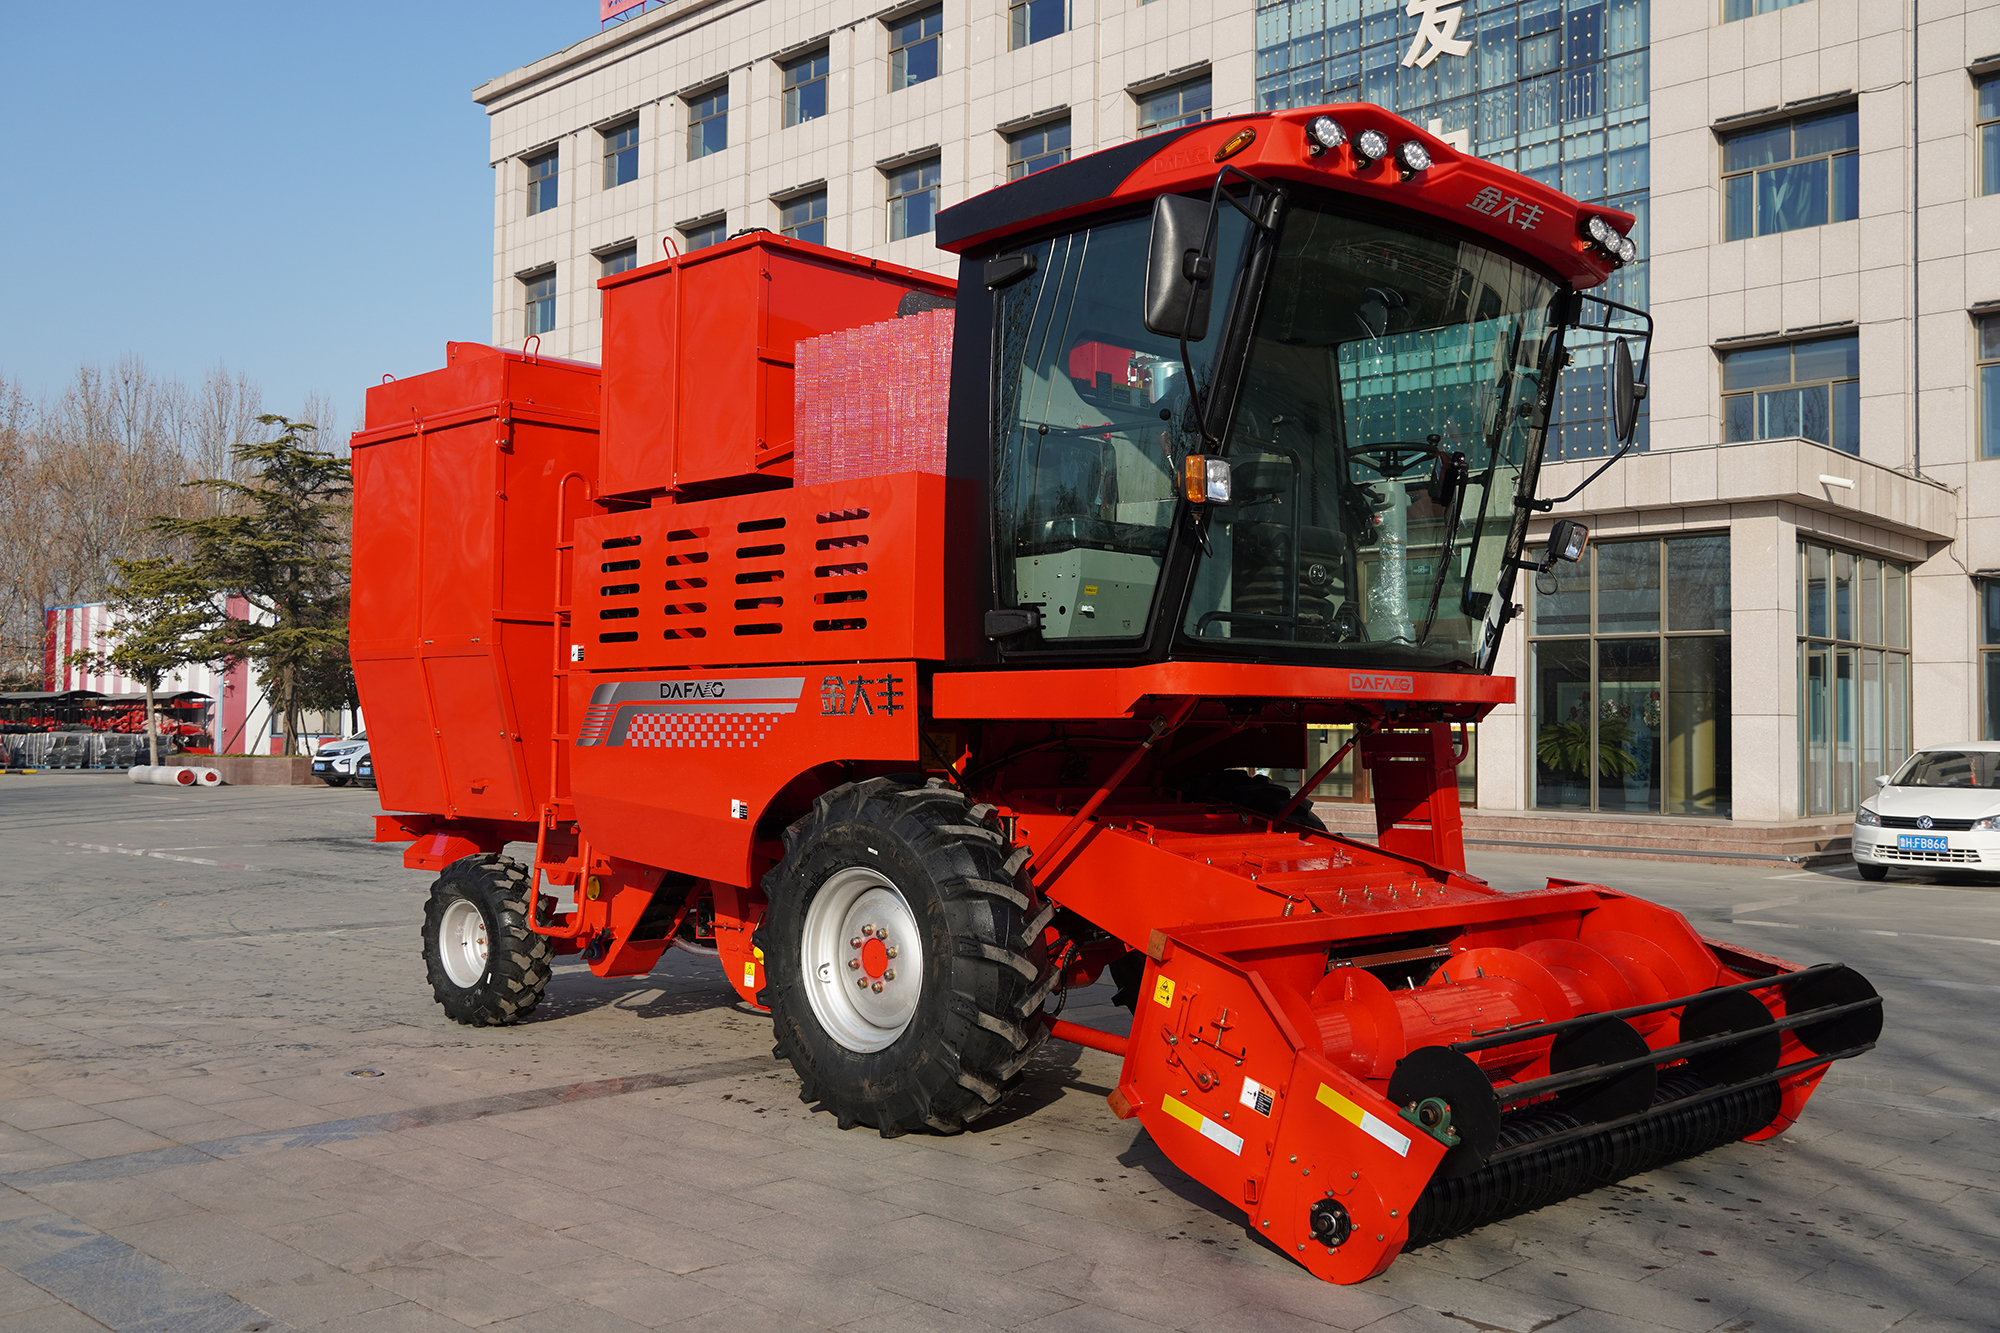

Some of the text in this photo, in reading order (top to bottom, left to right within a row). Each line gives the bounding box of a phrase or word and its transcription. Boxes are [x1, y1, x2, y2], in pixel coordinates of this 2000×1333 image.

[1465, 186, 1545, 230] 金大丰
[820, 673, 904, 716] 金大丰
